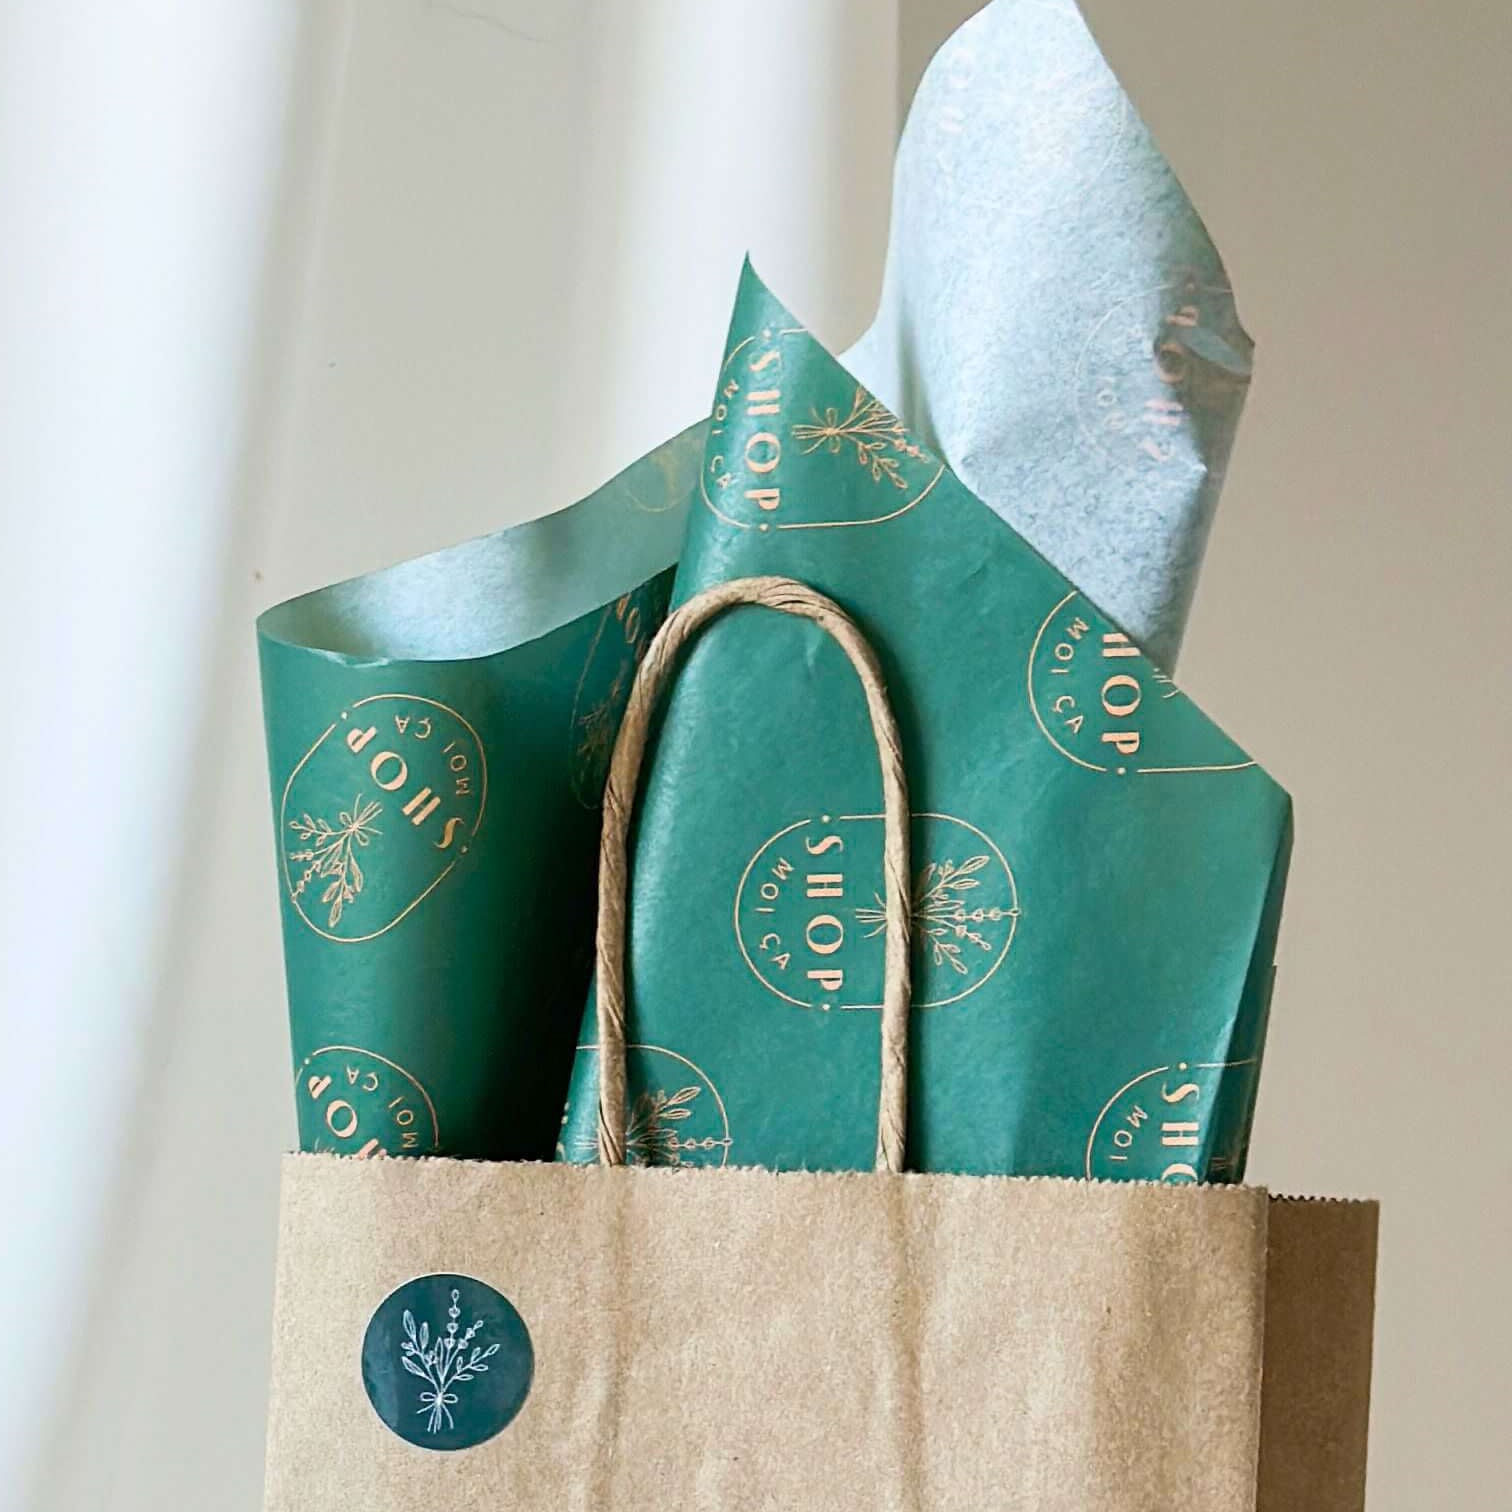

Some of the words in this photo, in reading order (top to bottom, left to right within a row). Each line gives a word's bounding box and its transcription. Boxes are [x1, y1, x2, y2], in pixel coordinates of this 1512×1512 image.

[744, 350, 781, 510] SHOP
[1050, 617, 1090, 674] MOI
[1102, 632, 1142, 754] HOP
[346, 726, 465, 849] SHOP
[443, 741, 470, 795] MOI
[754, 857, 795, 913] MOI
[805, 835, 844, 991] SHOP
[388, 1095, 419, 1149] MOI
[1109, 1105, 1148, 1160] MOI
